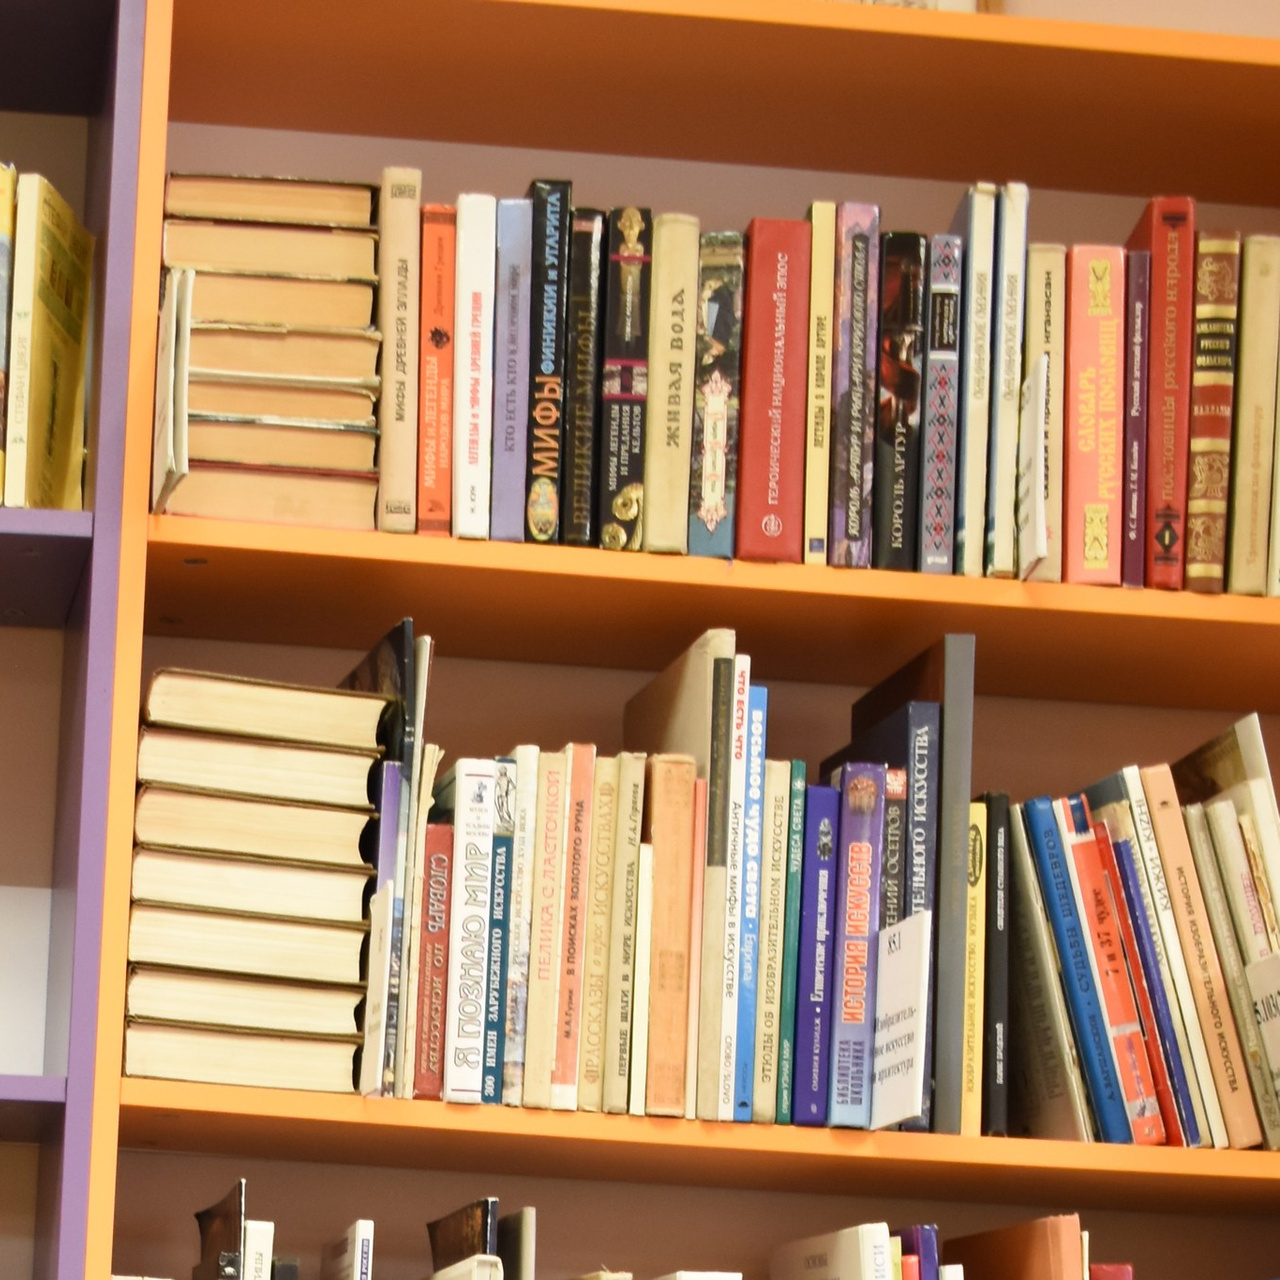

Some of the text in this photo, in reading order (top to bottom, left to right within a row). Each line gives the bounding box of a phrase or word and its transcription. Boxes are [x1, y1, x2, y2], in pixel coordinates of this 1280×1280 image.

[532, 193, 561, 478] МИФЫ ФИНИКИИ и УГАРИТА
[666, 288, 685, 448] ЖИВАЯ ВОДА
[768, 253, 788, 505] ГЕРОИЧЕСКИЙ НАЦИОНАЛЬНЫЙ ЭПОС
[891, 422, 907, 548] КОРОЛЬ АРТУР
[454, 842, 489, 1069] Я ПОЗНАЮ МИР
[485, 847, 506, 1096] 300 ИМЕН ЗАРУБЕЖНОГО ИСКУССТВА
[842, 842, 871, 1023] ИСТОРИЯ ИСКУССТВ
